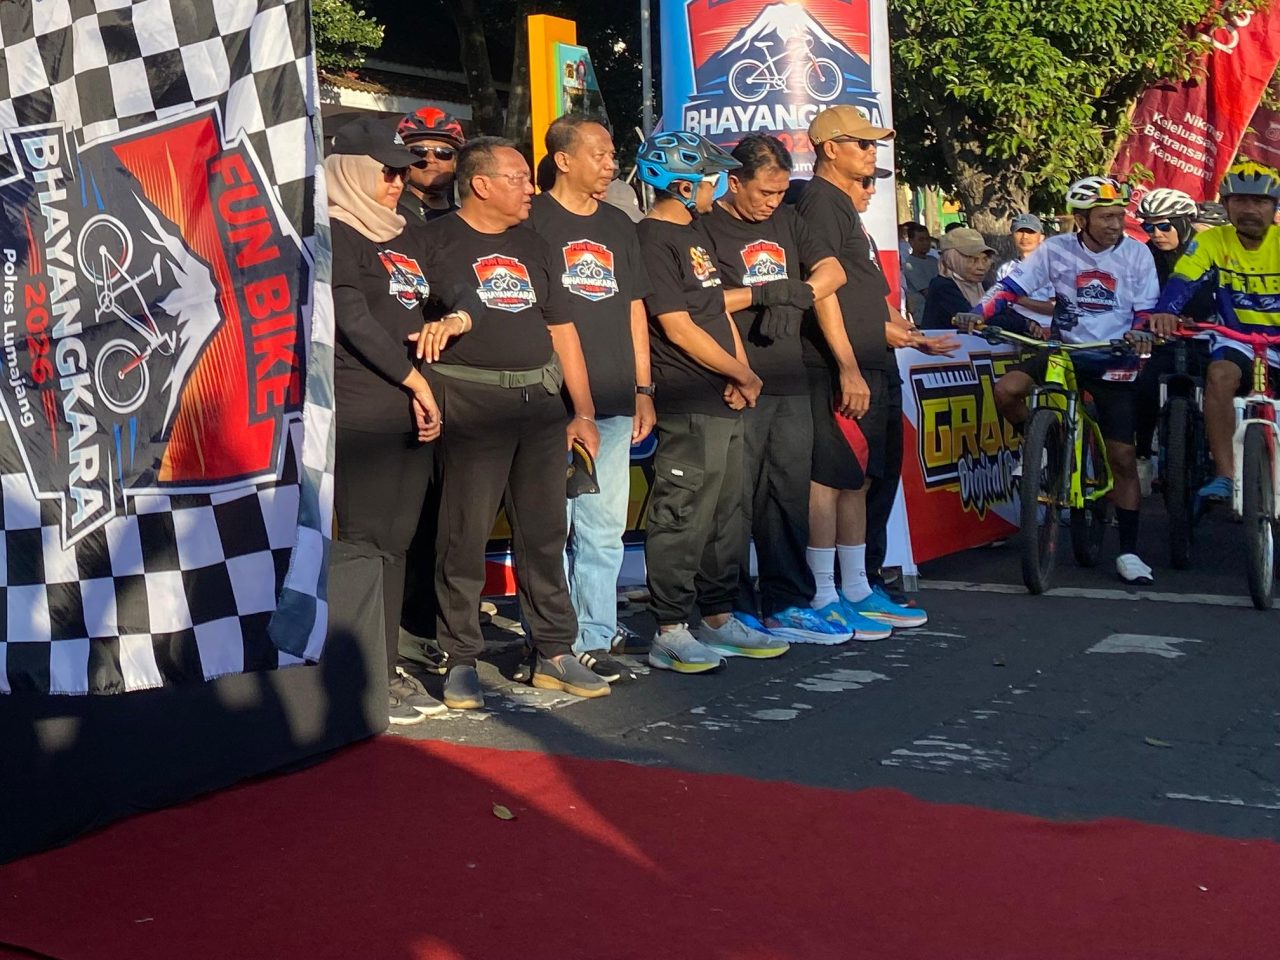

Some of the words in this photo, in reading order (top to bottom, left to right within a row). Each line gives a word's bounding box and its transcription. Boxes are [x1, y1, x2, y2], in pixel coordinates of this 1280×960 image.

[213, 154, 278, 270] FUN
[2, 247, 17, 315] Polres
[21, 134, 104, 526] BHAYANGKARA
[23, 282, 54, 385] 2026
[3, 319, 36, 428] Lumajang
[243, 274, 299, 415] BIKE
